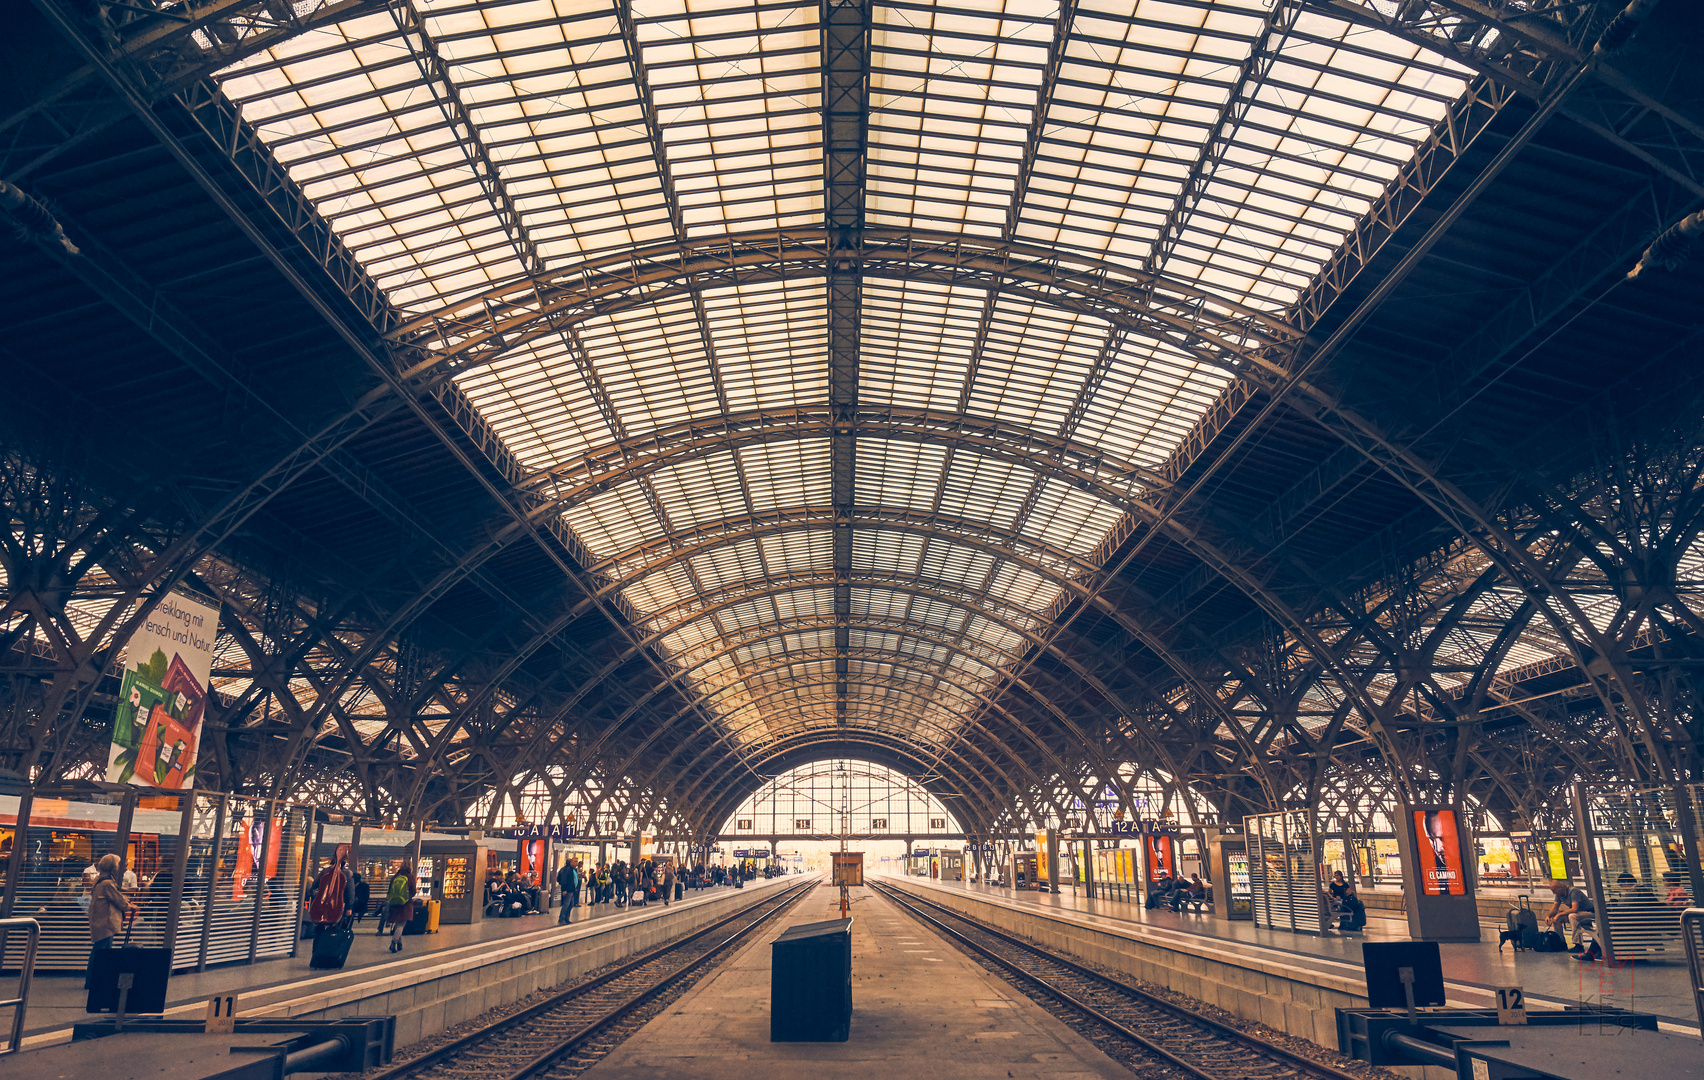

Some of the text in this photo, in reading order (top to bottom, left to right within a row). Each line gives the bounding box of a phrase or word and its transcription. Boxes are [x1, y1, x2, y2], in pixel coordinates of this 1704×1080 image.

[192, 613, 204, 627] mit
[172, 628, 188, 644] und
[188, 631, 211, 653] Natur.
[935, 819, 942, 828] 13
[1115, 821, 1140, 832] 12 A
[1152, 821, 1161, 832] A
[530, 825, 539, 836] A
[551, 825, 576, 836] A 11
[36, 840, 42, 854] 2
[1429, 871, 1456, 880] EL CAMINO
[1498, 989, 1523, 1010] 12
[213, 996, 233, 1017] 11
